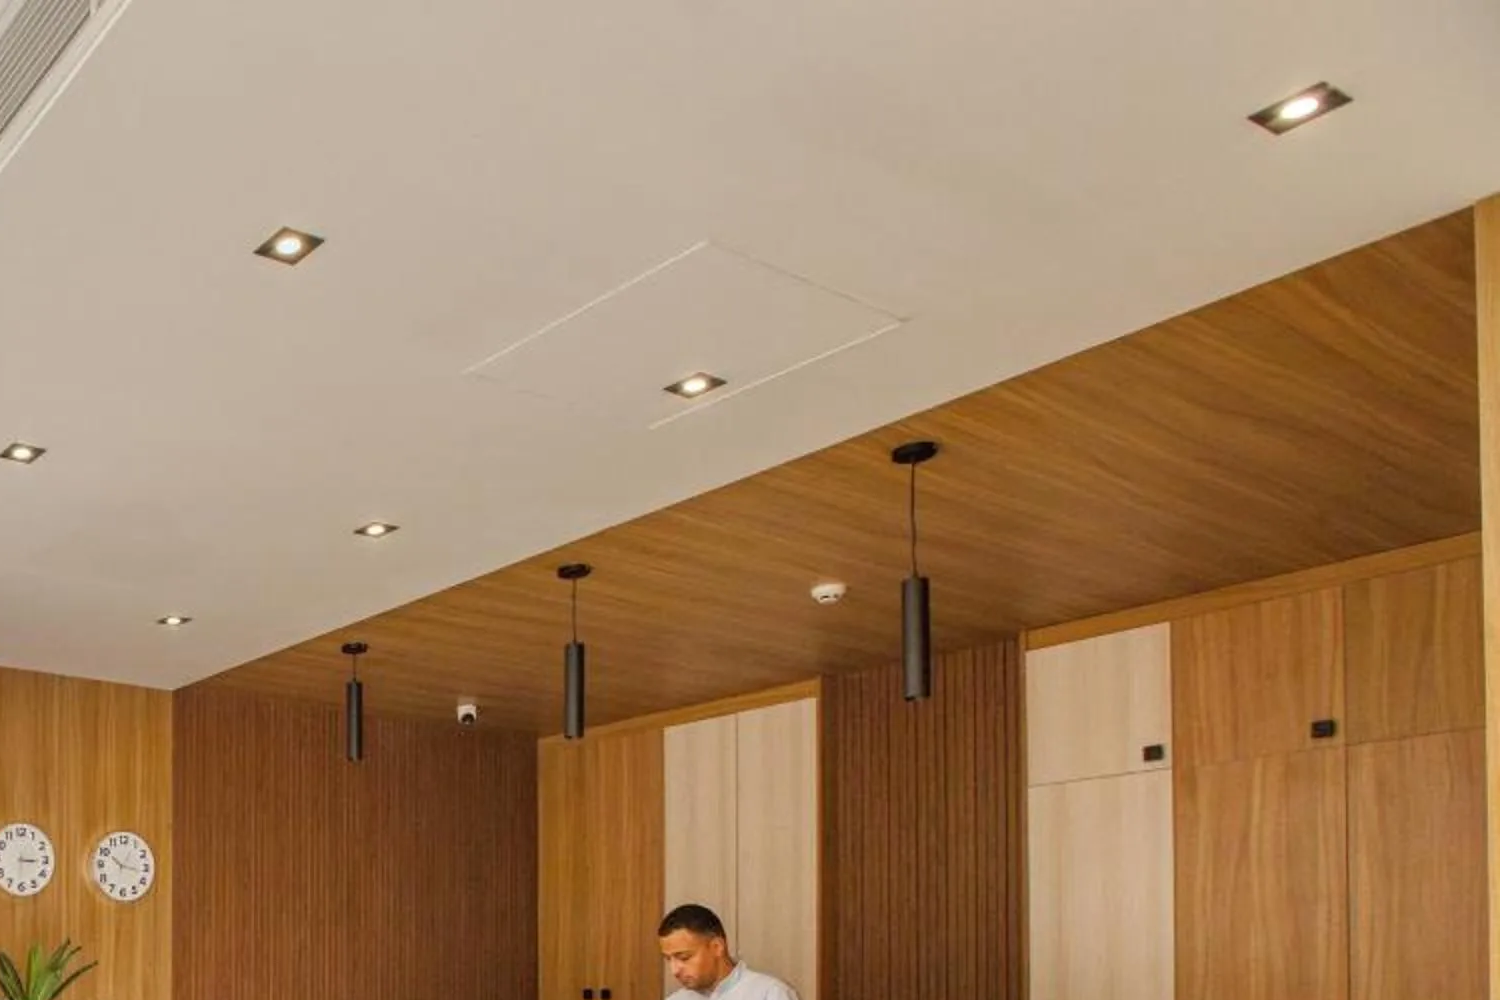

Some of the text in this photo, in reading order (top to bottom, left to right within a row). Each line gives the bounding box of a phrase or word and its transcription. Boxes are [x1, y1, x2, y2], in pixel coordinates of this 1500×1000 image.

[5, 831, 13, 840] 11
[15, 827, 26, 837] 12
[7, 877, 13, 888] 7
[17, 882, 27, 892] 6
